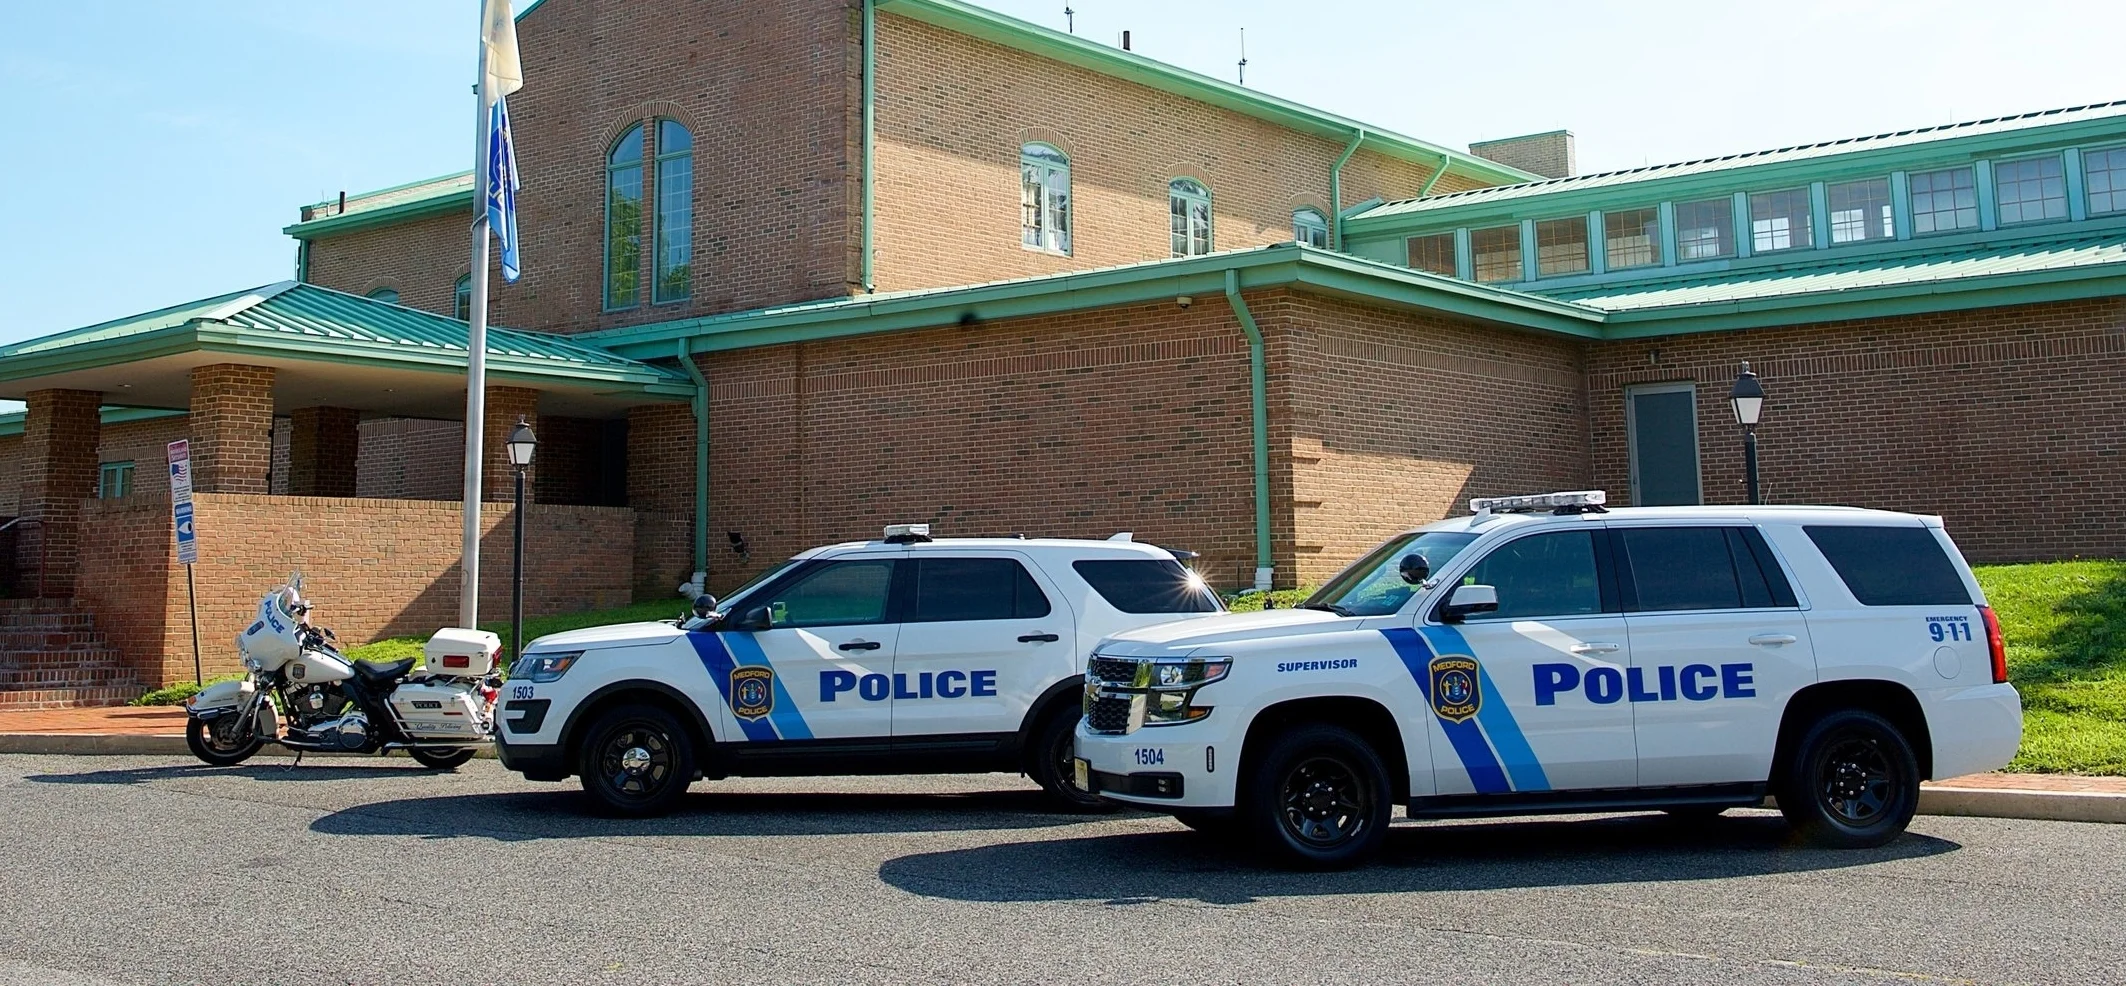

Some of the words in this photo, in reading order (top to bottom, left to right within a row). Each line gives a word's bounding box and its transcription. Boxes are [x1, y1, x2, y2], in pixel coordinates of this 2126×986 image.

[265, 600, 285, 634] POLICE
[1929, 622, 1972, 643] 9-1-1
[1277, 658, 1358, 673] SUPERVISOR
[1432, 660, 1475, 673] MEDFORD
[733, 670, 771, 680] MEDFORD
[819, 670, 997, 703] POLICE
[1532, 662, 1756, 706] POLICE
[512, 685, 534, 700] 1503
[738, 705, 768, 715] POLICE
[1440, 703, 1476, 715] POLICE
[1134, 748, 1165, 765] 1504
